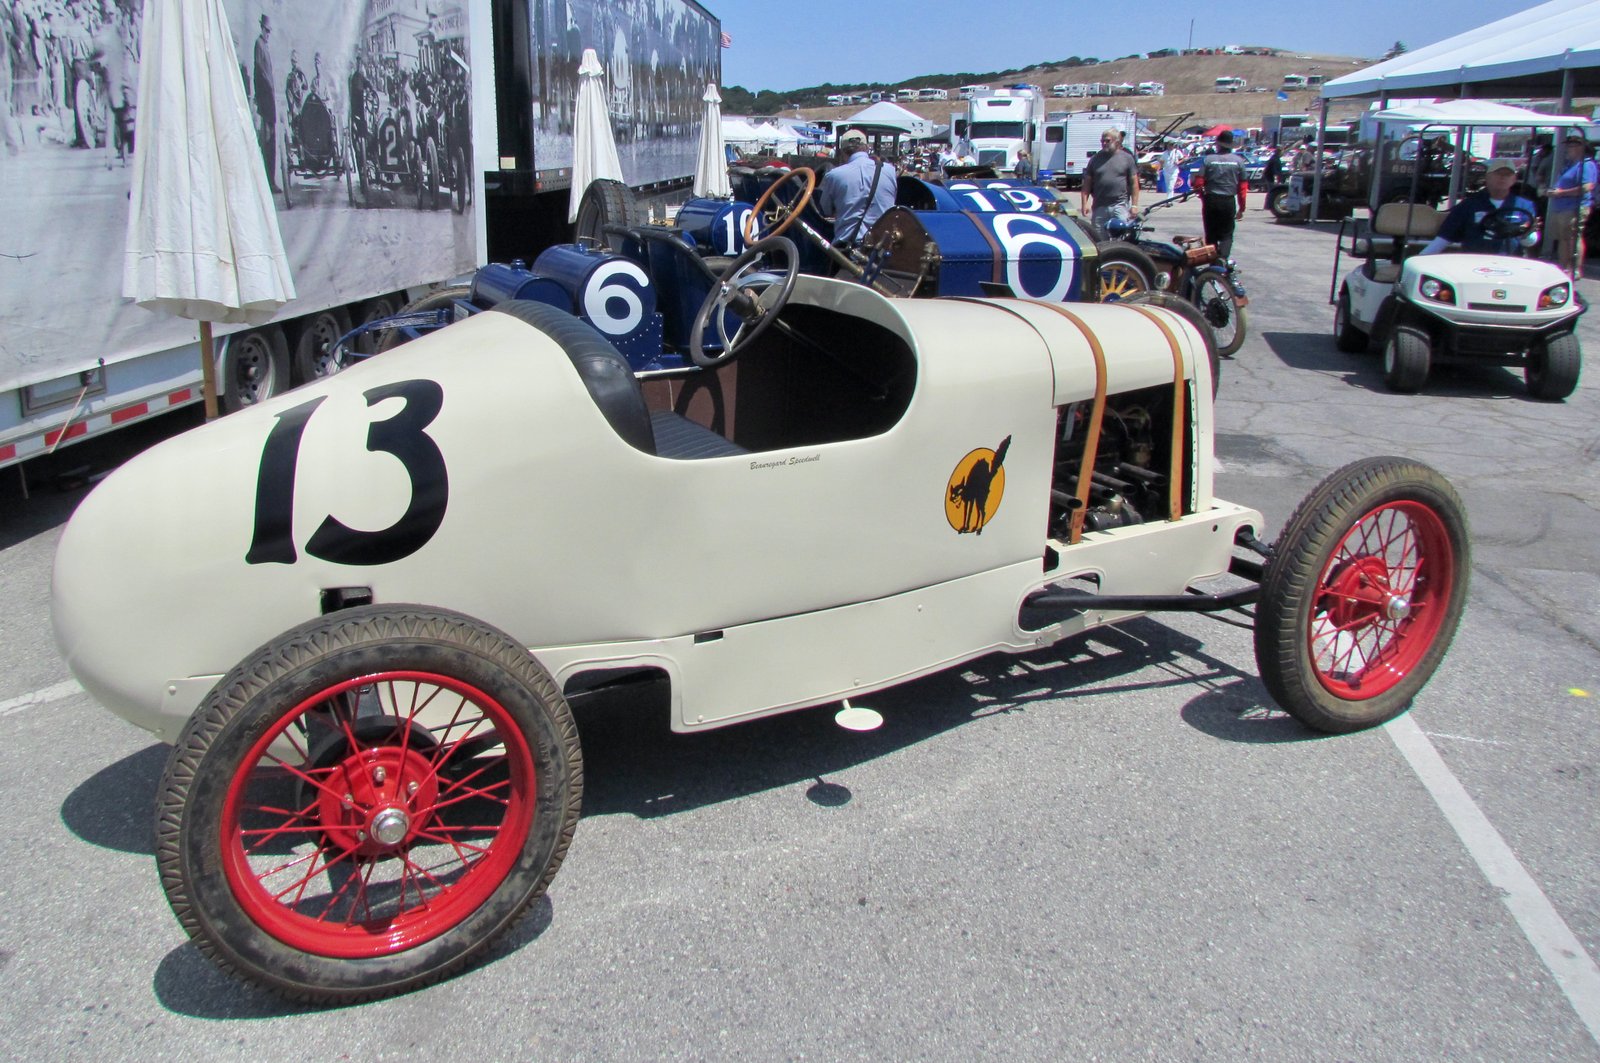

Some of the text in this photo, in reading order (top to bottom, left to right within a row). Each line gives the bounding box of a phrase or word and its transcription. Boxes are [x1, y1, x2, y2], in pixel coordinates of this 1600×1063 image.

[385, 125, 398, 165] 2
[963, 189, 1043, 212] 19
[723, 208, 760, 256] 19
[992, 213, 1074, 303] 6
[584, 260, 649, 335] 6
[245, 378, 449, 566] 13
[750, 454, 821, 470] Beauregard Speedwell
